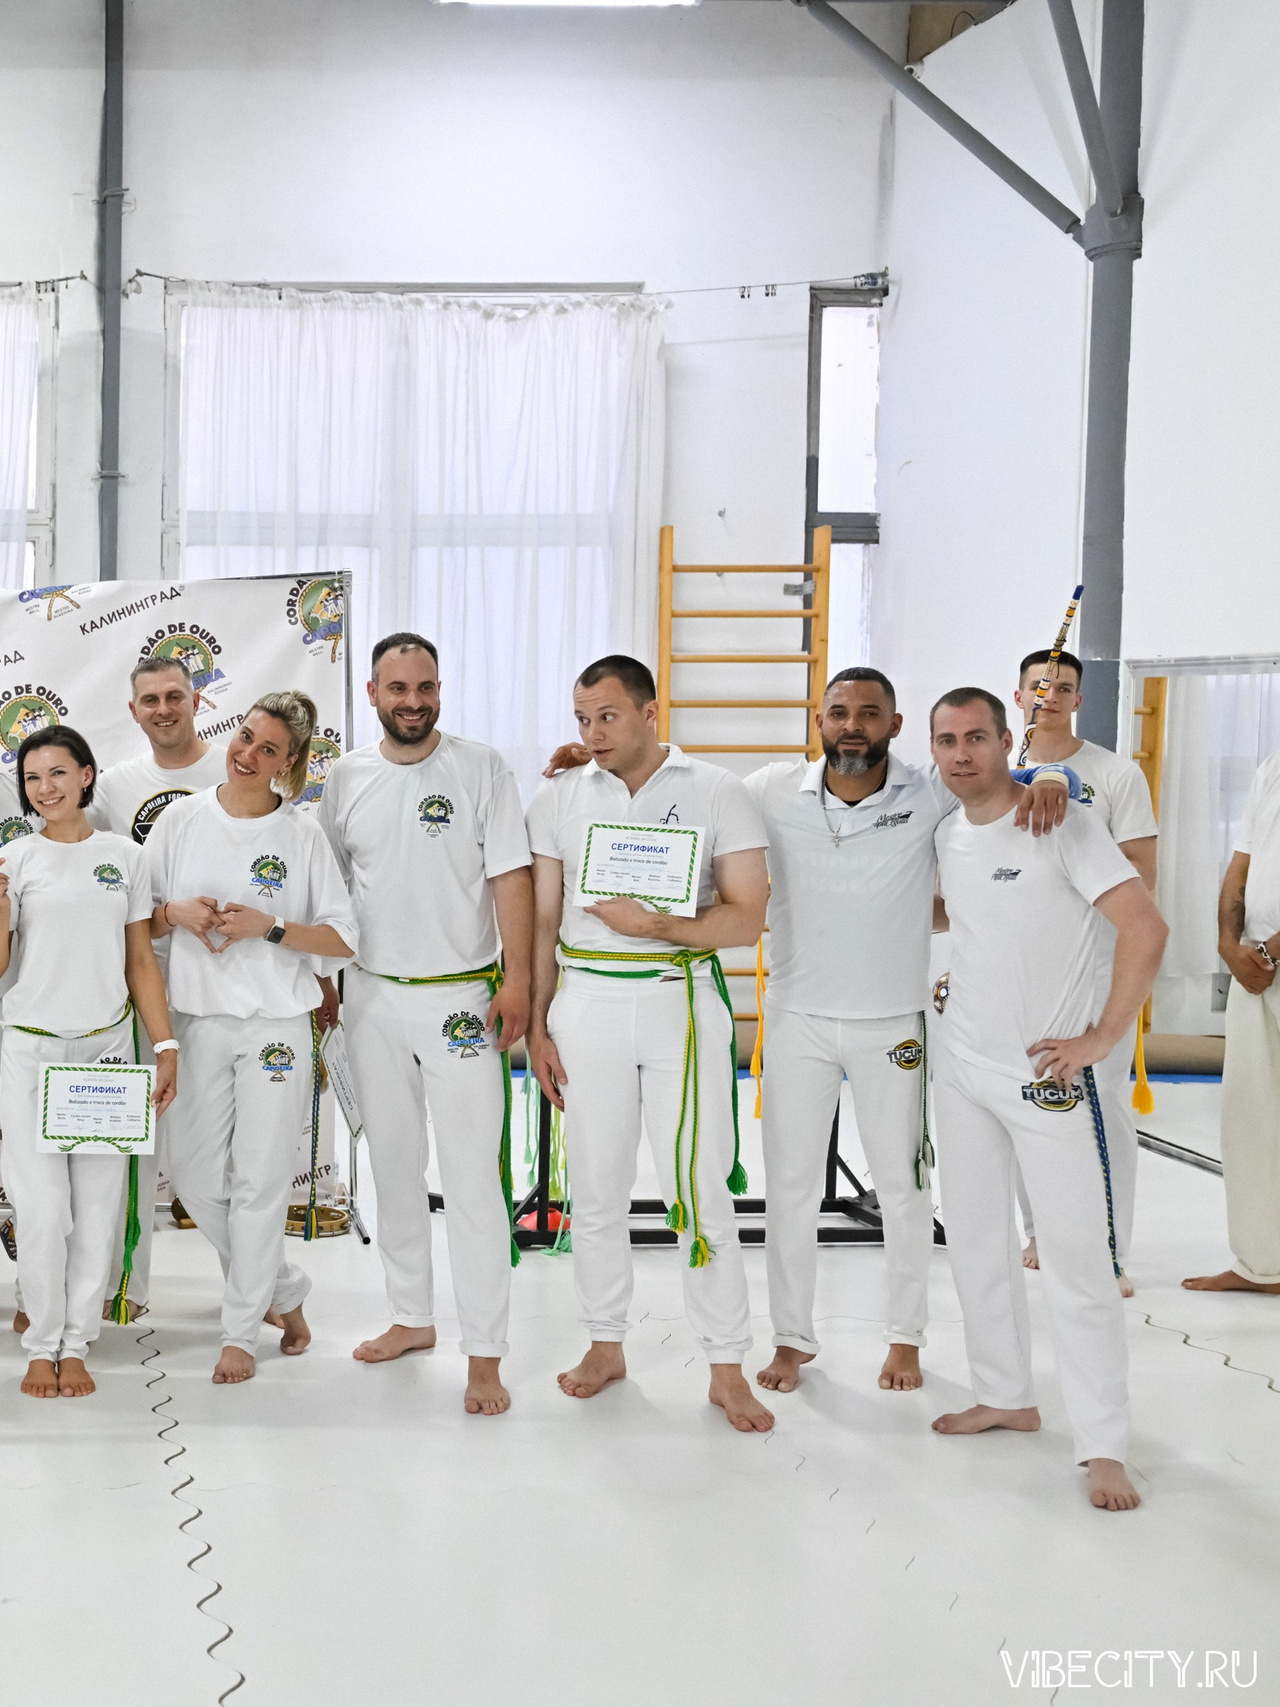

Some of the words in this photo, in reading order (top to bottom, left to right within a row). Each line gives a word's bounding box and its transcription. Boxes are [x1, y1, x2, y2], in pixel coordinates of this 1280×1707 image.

[79, 586, 182, 636] КАЛИНИНГРАД
[286, 579, 313, 626] CORDÃ
[167, 622, 186, 635] DE
[189, 624, 222, 655] OURO
[192, 668, 226, 690] EIRA
[14, 684, 32, 696] DE
[35, 685, 69, 717] OURO
[137, 794, 167, 821] CAPOEIRA
[611, 842, 670, 855] СЕРТИФИКАТ
[249, 854, 270, 872] CORDÃO
[442, 1012, 459, 1037] CORDÃO
[471, 1014, 485, 1032] OURO
[69, 1085, 127, 1095] СЕРТИФИКАТ
[1022, 1087, 1082, 1100] TUCUM
